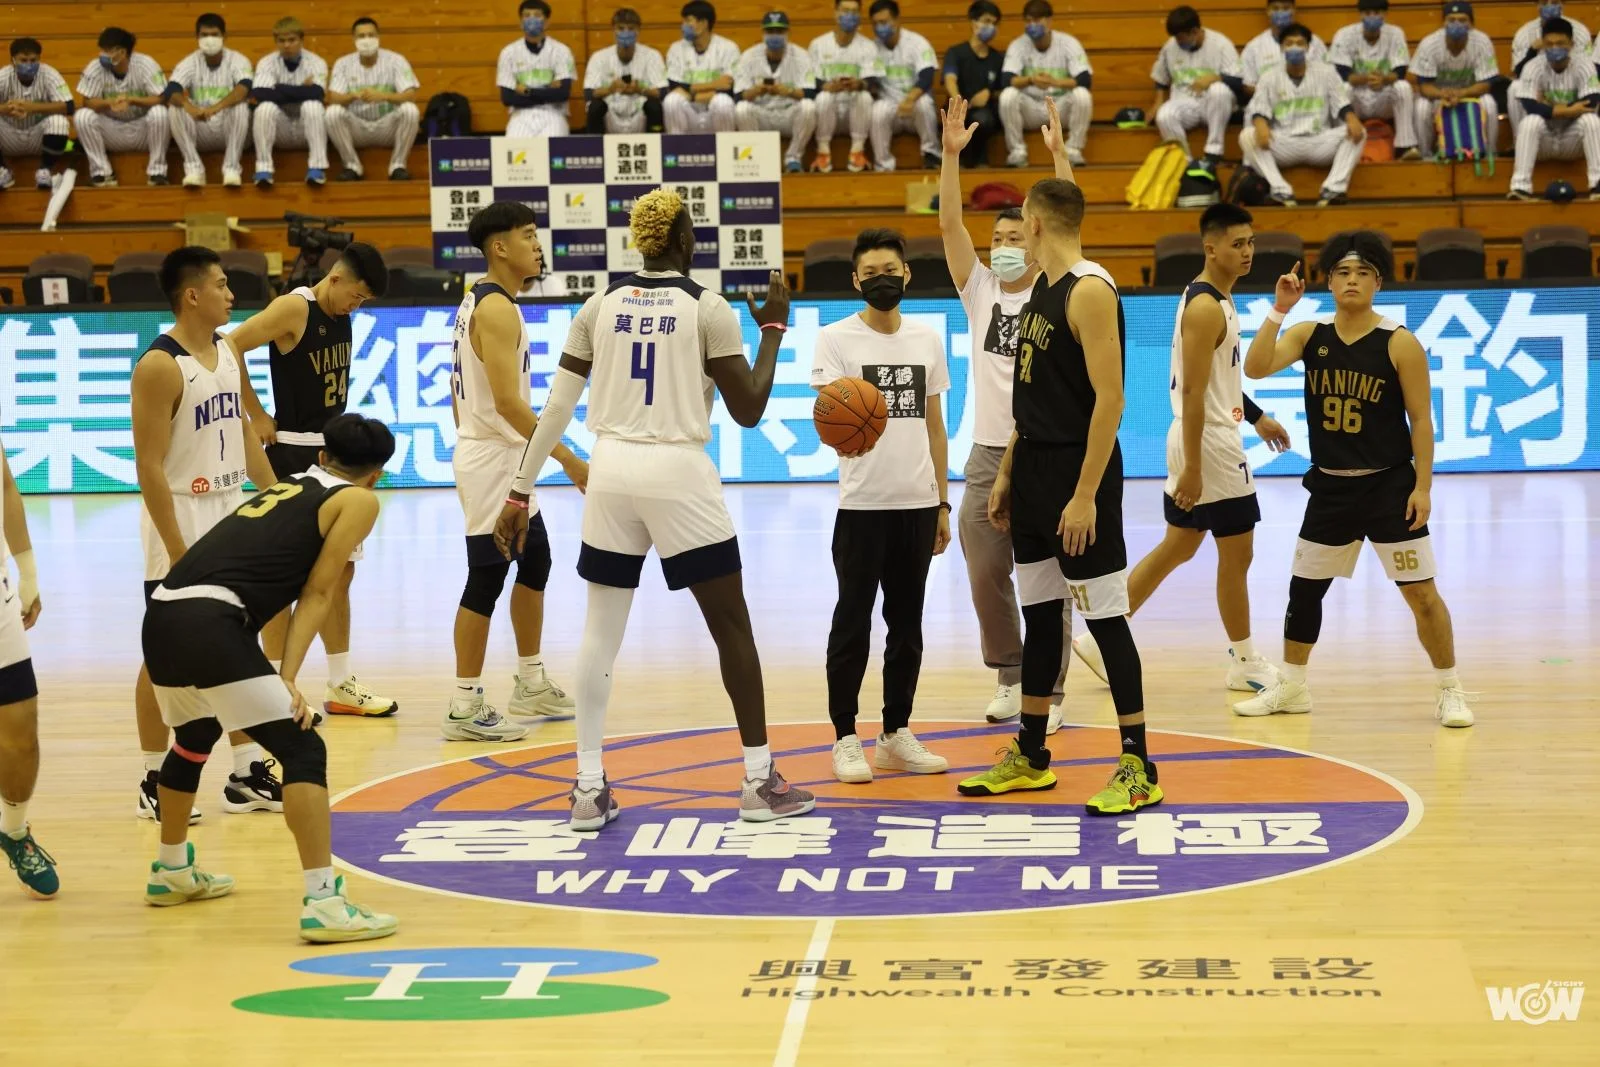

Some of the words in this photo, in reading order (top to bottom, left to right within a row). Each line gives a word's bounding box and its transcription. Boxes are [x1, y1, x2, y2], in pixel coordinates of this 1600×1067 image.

[622, 297, 655, 307] PHILIPS
[614, 314, 676, 336] 莫巴耶
[308, 342, 352, 375] VANUN
[631, 342, 655, 405] 4
[325, 369, 347, 407] 24
[1306, 369, 1386, 403] VANUNG
[1322, 396, 1362, 434] 96
[219, 429, 225, 461] 1
[1238, 462, 1249, 484] 7
[1393, 549, 1419, 571] 96
[379, 812, 1330, 863] 登峰造極
[536, 868, 740, 894] WHY
[777, 867, 974, 893] NOT
[1020, 865, 1160, 890] ME
[747, 958, 1375, 981] 興富發建設
[740, 986, 1032, 1001] Highwealth
[1054, 985, 1382, 999] Construction
